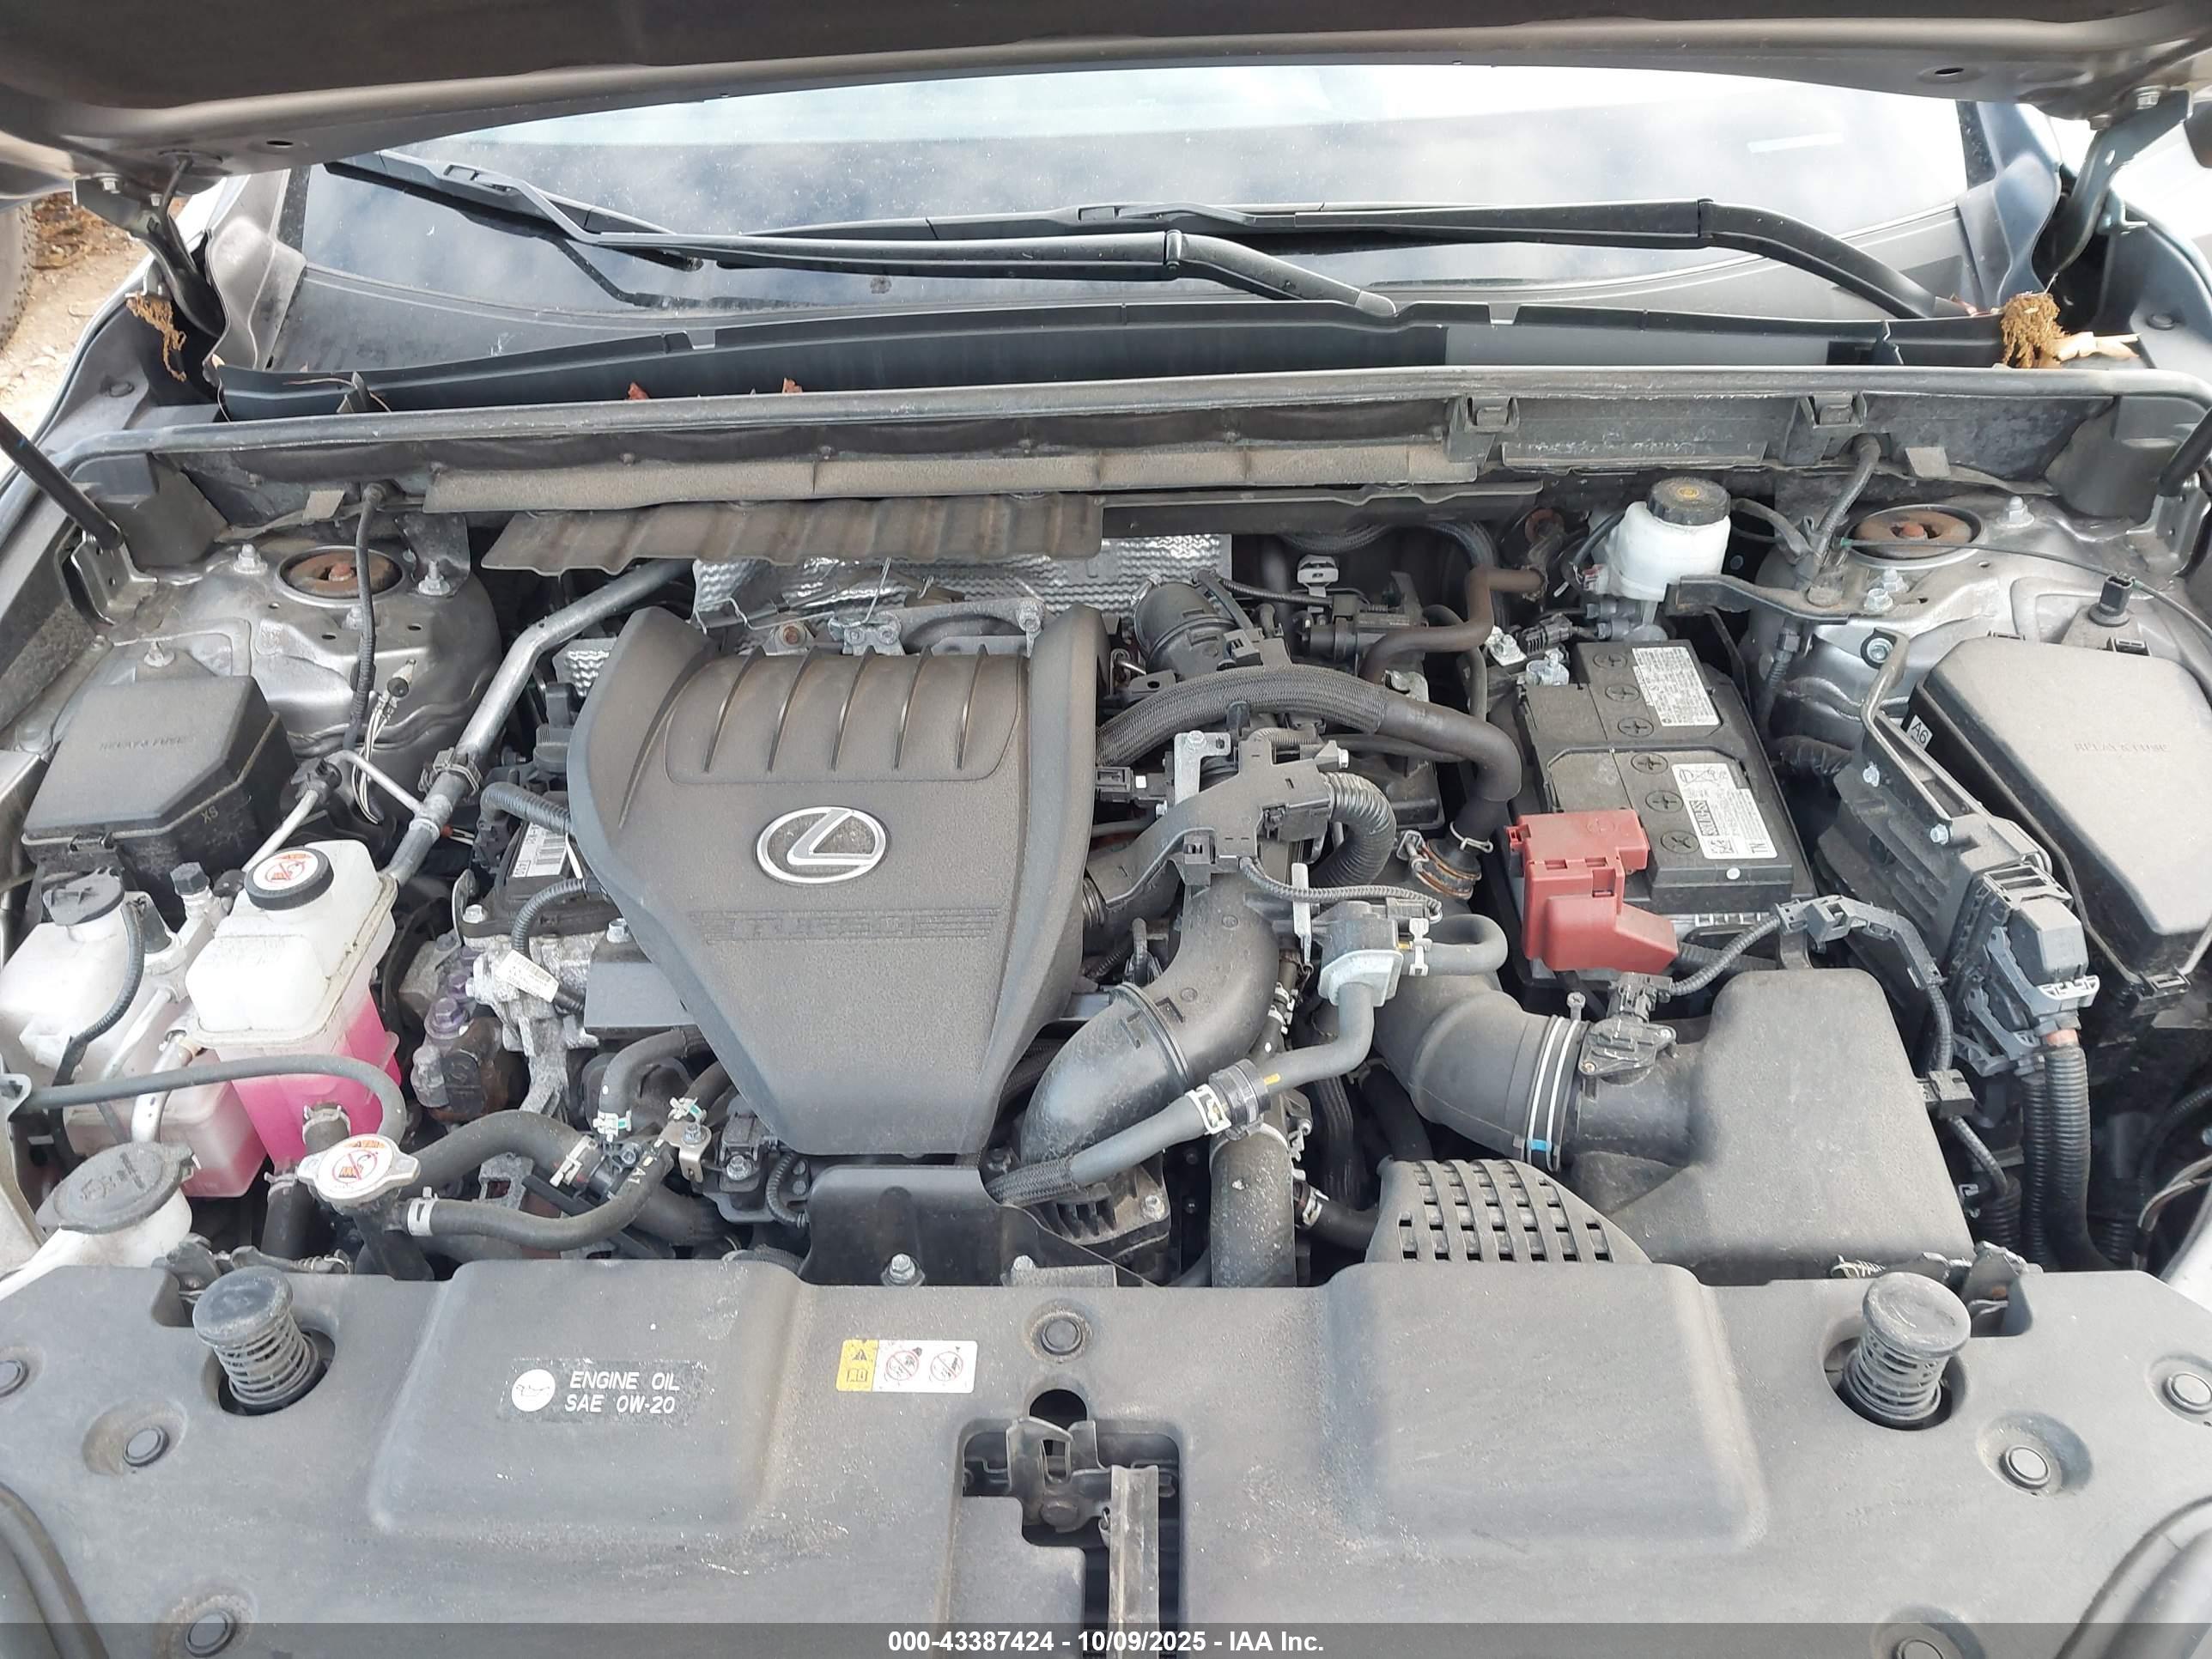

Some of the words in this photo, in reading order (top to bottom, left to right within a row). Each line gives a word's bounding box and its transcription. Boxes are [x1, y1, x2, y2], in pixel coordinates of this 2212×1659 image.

[1911, 721, 1929, 744] A6
[569, 1371, 640, 1390] ENGINE
[651, 1372, 680, 1391] OIL
[564, 1394, 605, 1413] SAE
[616, 1395, 676, 1414] 0W-20
